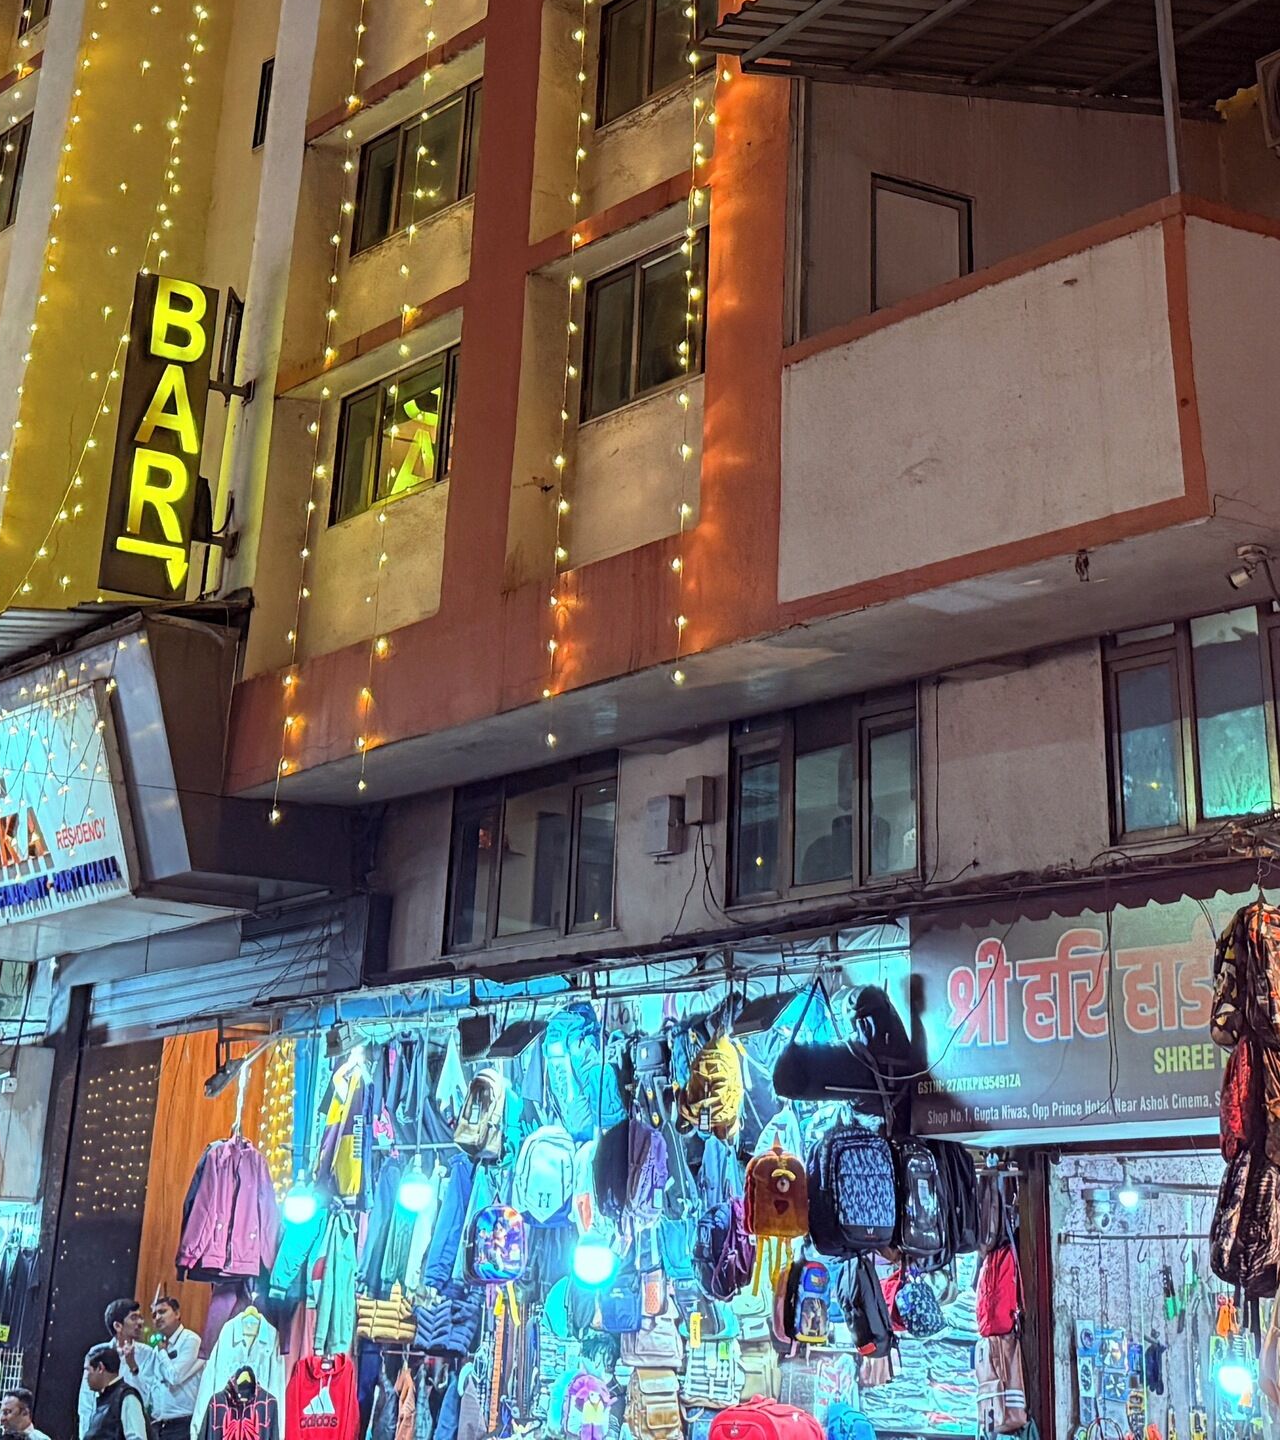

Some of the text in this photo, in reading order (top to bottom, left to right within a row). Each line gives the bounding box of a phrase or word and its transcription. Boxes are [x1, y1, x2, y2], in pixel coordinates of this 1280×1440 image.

[127, 276, 208, 543] BAR
[56, 817, 107, 850] RESIDENCY
[53, 863, 84, 893] PARTY
[86, 856, 118, 885] HALL
[947, 937, 1011, 1047] श्री
[1016, 928, 1111, 1042] हरि
[1153, 1044, 1215, 1074] SHREE
[927, 1110, 948, 1126] Shop
[974, 1107, 999, 1123] Gupta
[1001, 1104, 1030, 1120] Niwas,
[1032, 1103, 1050, 1120] Opp
[1052, 1100, 1082, 1117] Prince
[1114, 1096, 1138, 1111] Near
[1140, 1094, 1169, 1111] Ashok
[1171, 1092, 1213, 1110] Cinema,
[299, 1415, 338, 1429] adidas
